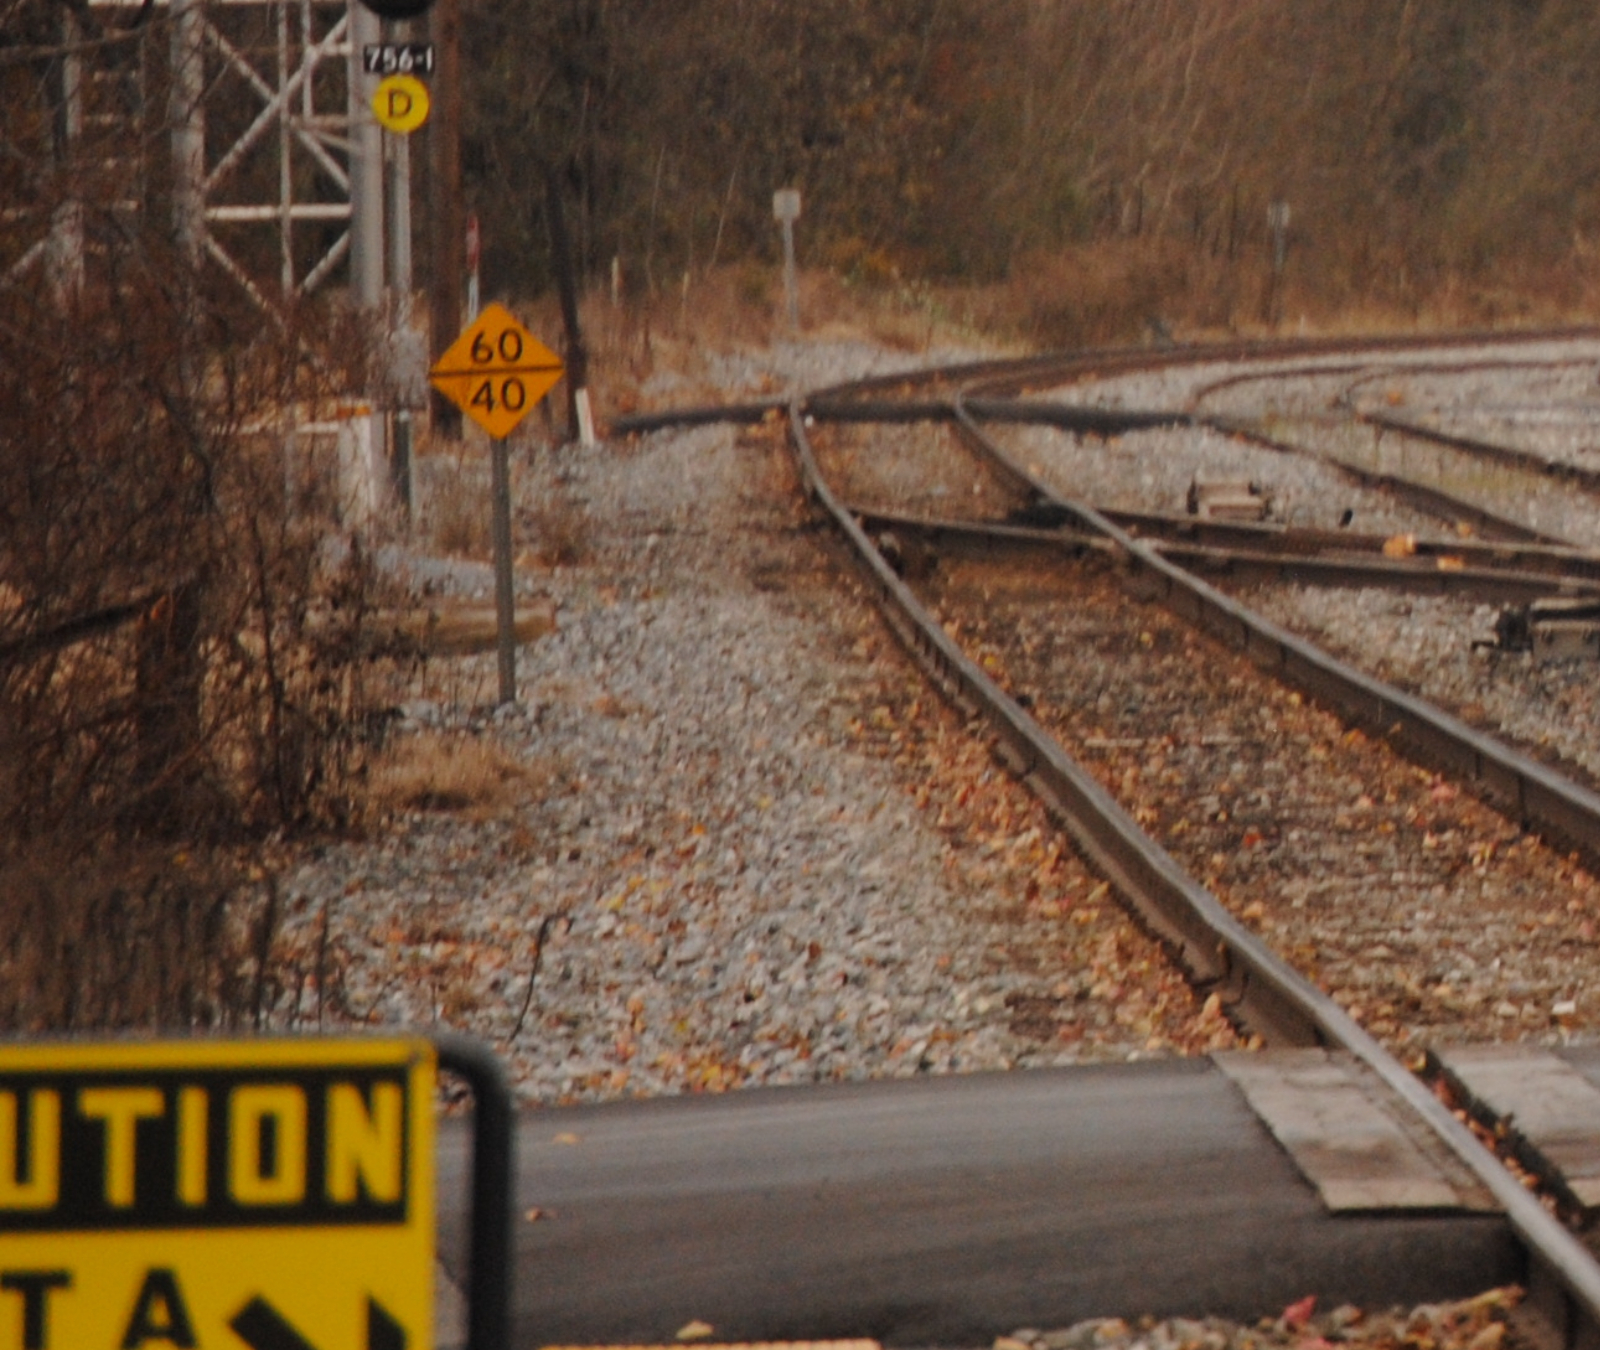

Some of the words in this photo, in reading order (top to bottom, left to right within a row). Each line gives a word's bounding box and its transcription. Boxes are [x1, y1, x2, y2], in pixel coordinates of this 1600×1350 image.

[366, 45, 434, 73] 756-1
[388, 88, 413, 119] D
[471, 328, 522, 364] 60
[470, 376, 526, 415] 40
